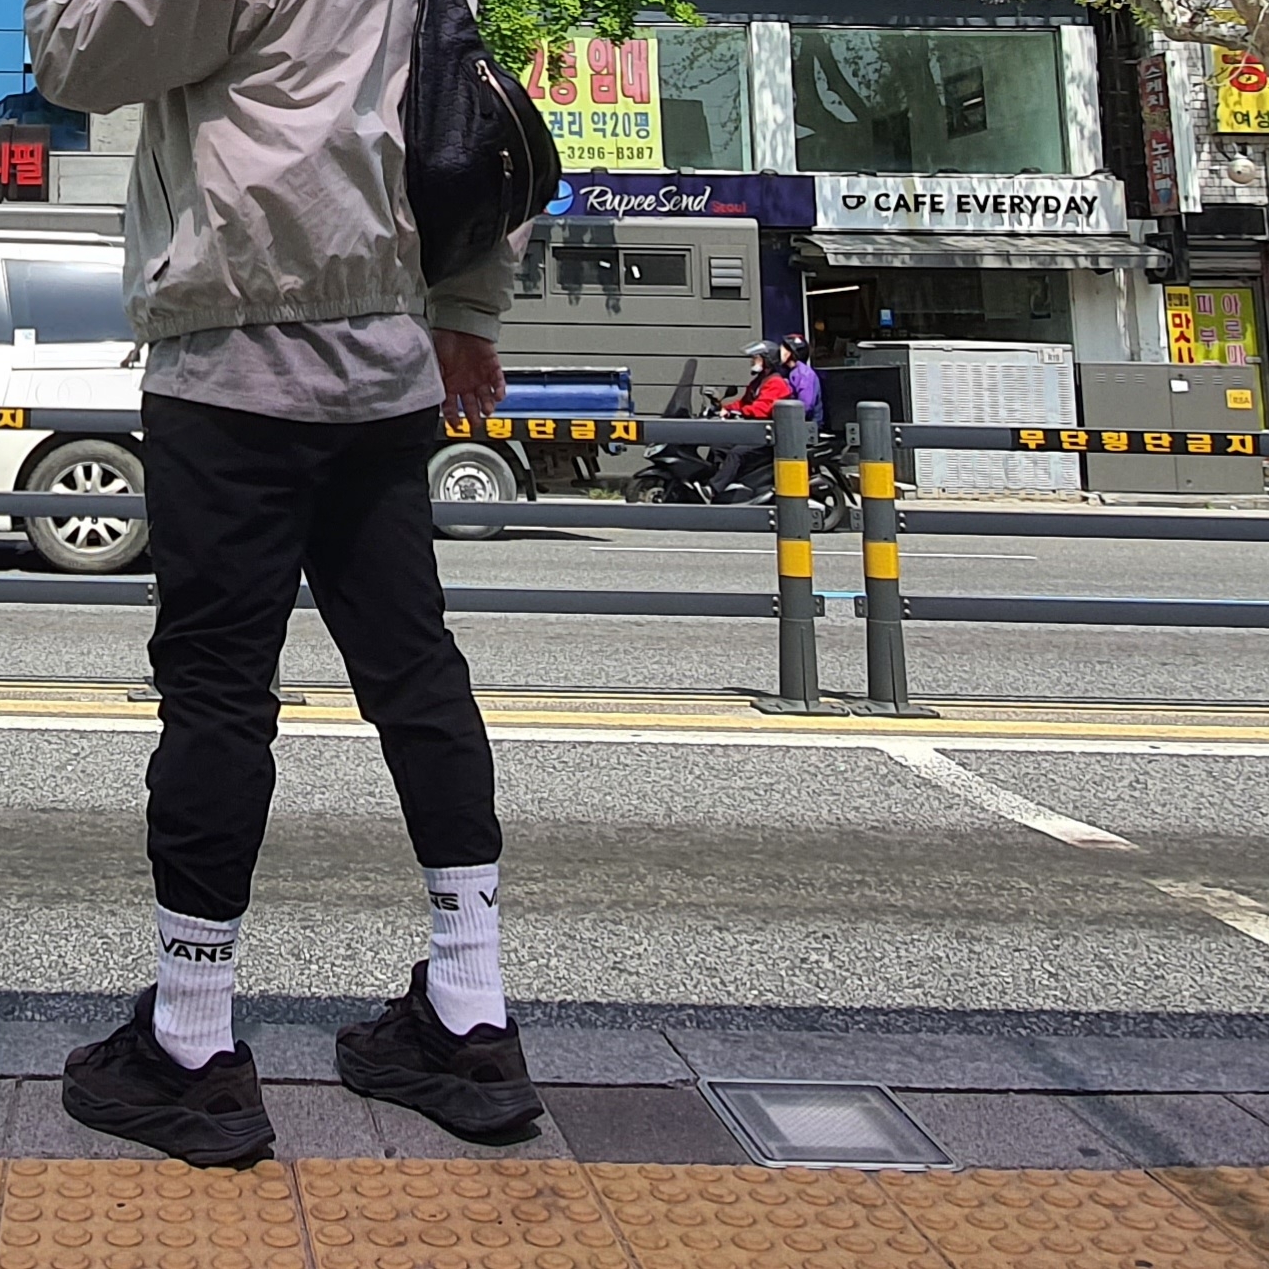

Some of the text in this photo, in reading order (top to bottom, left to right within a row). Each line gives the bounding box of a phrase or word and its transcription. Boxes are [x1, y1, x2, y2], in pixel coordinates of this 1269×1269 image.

[587, 38, 651, 104] 임대
[542, 111, 584, 139] 권리
[874, 193, 1098, 216] CAFE EVERYDAY
[1195, 293, 1218, 364] 피부
[159, 930, 234, 963] VANS
